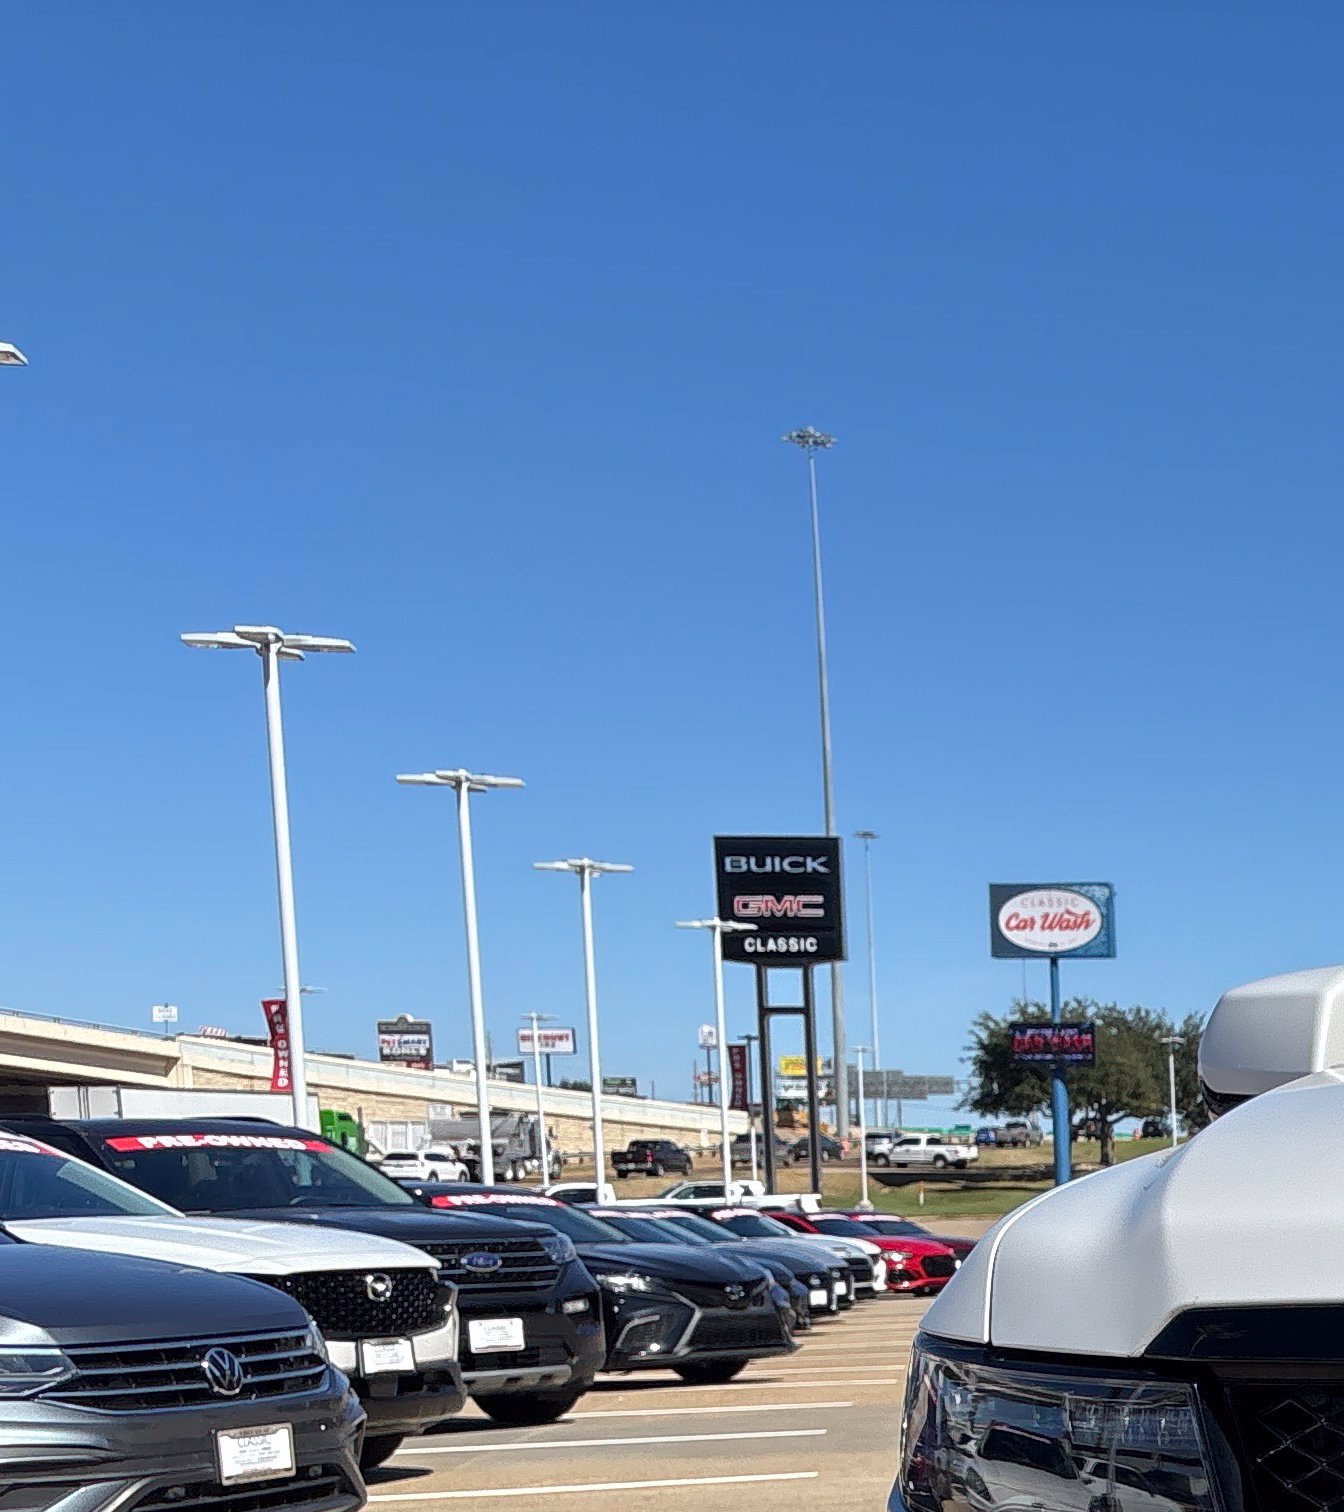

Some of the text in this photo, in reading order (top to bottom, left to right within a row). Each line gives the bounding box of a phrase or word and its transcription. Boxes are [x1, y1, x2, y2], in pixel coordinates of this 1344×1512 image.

[724, 855, 831, 873] BUICK
[733, 894, 825, 918] GMC
[1020, 895, 1079, 909] CLASSIC
[1005, 907, 1096, 932] Car Wash
[744, 936, 818, 953] CLASSIC
[136, 1134, 307, 1150] PRE-OWNED
